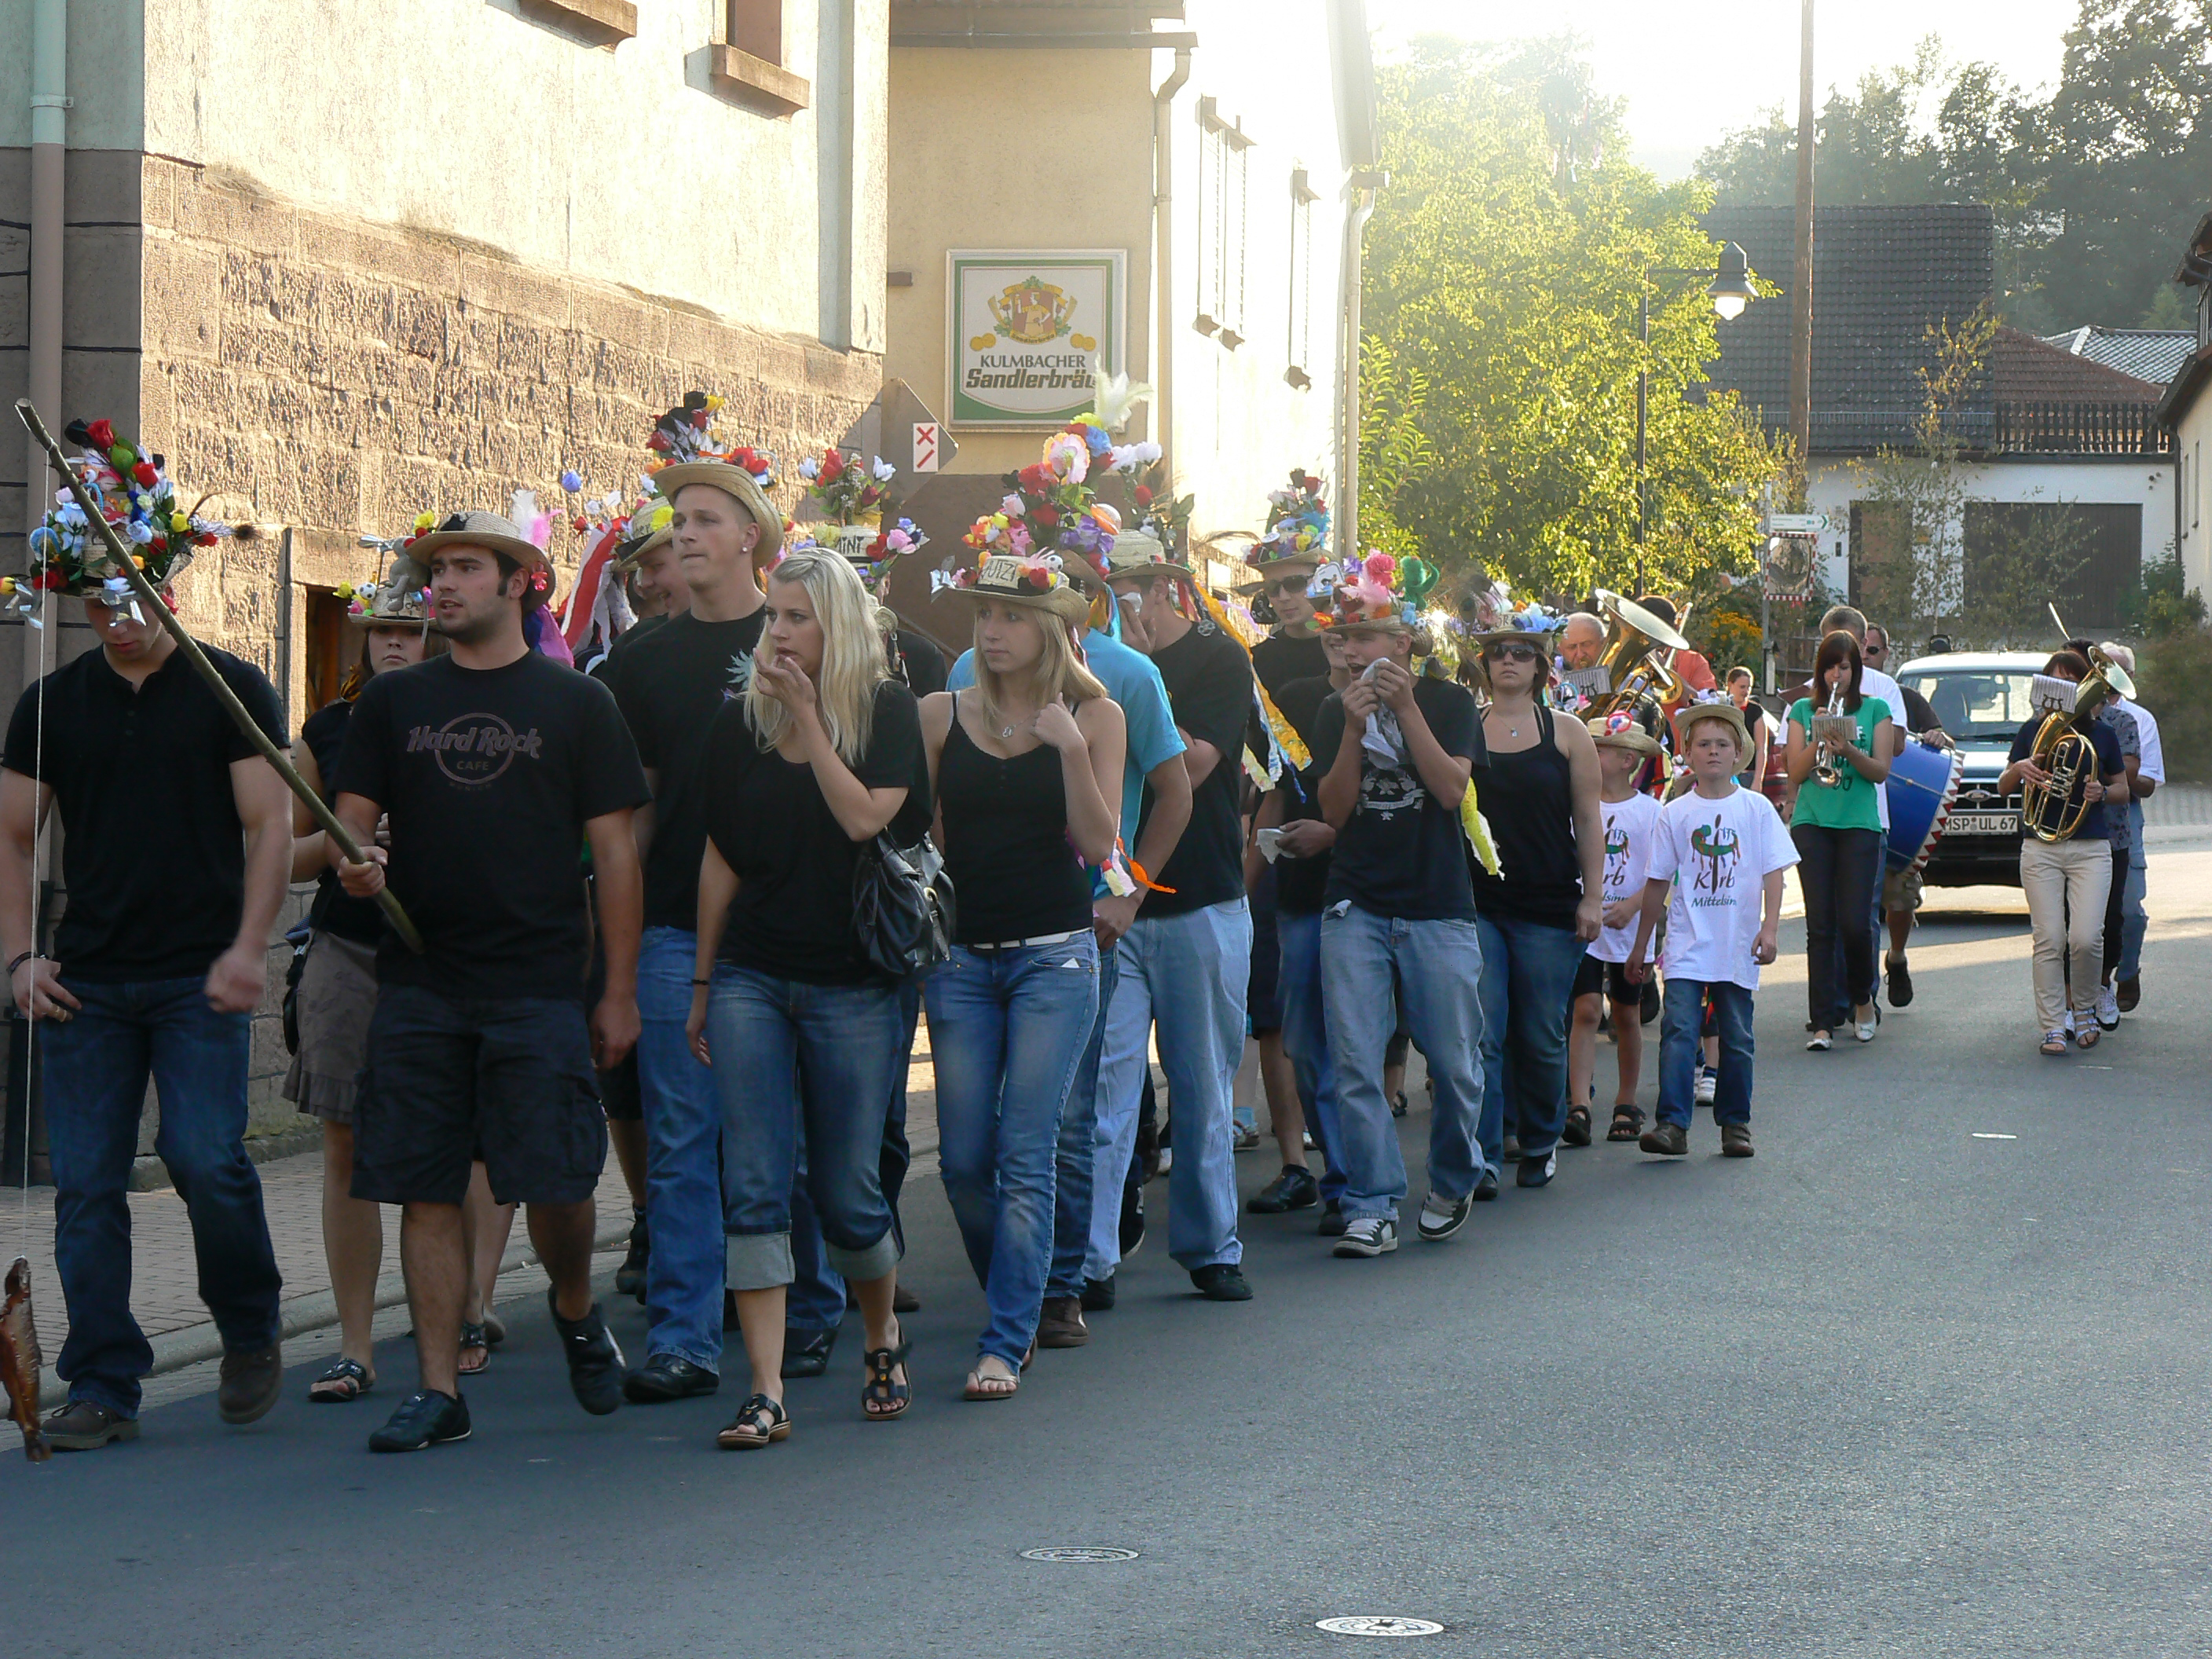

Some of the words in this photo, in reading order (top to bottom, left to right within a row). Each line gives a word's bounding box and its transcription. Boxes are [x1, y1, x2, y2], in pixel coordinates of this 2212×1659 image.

[980, 354, 1086, 368] KULMBACHER
[966, 368, 1095, 389] Sandlerbräu
[406, 725, 478, 752] Hard
[476, 727, 543, 760] Rock
[456, 760, 489, 771] CAFE
[1979, 817, 1998, 831] UL
[1999, 817, 2016, 830] 67
